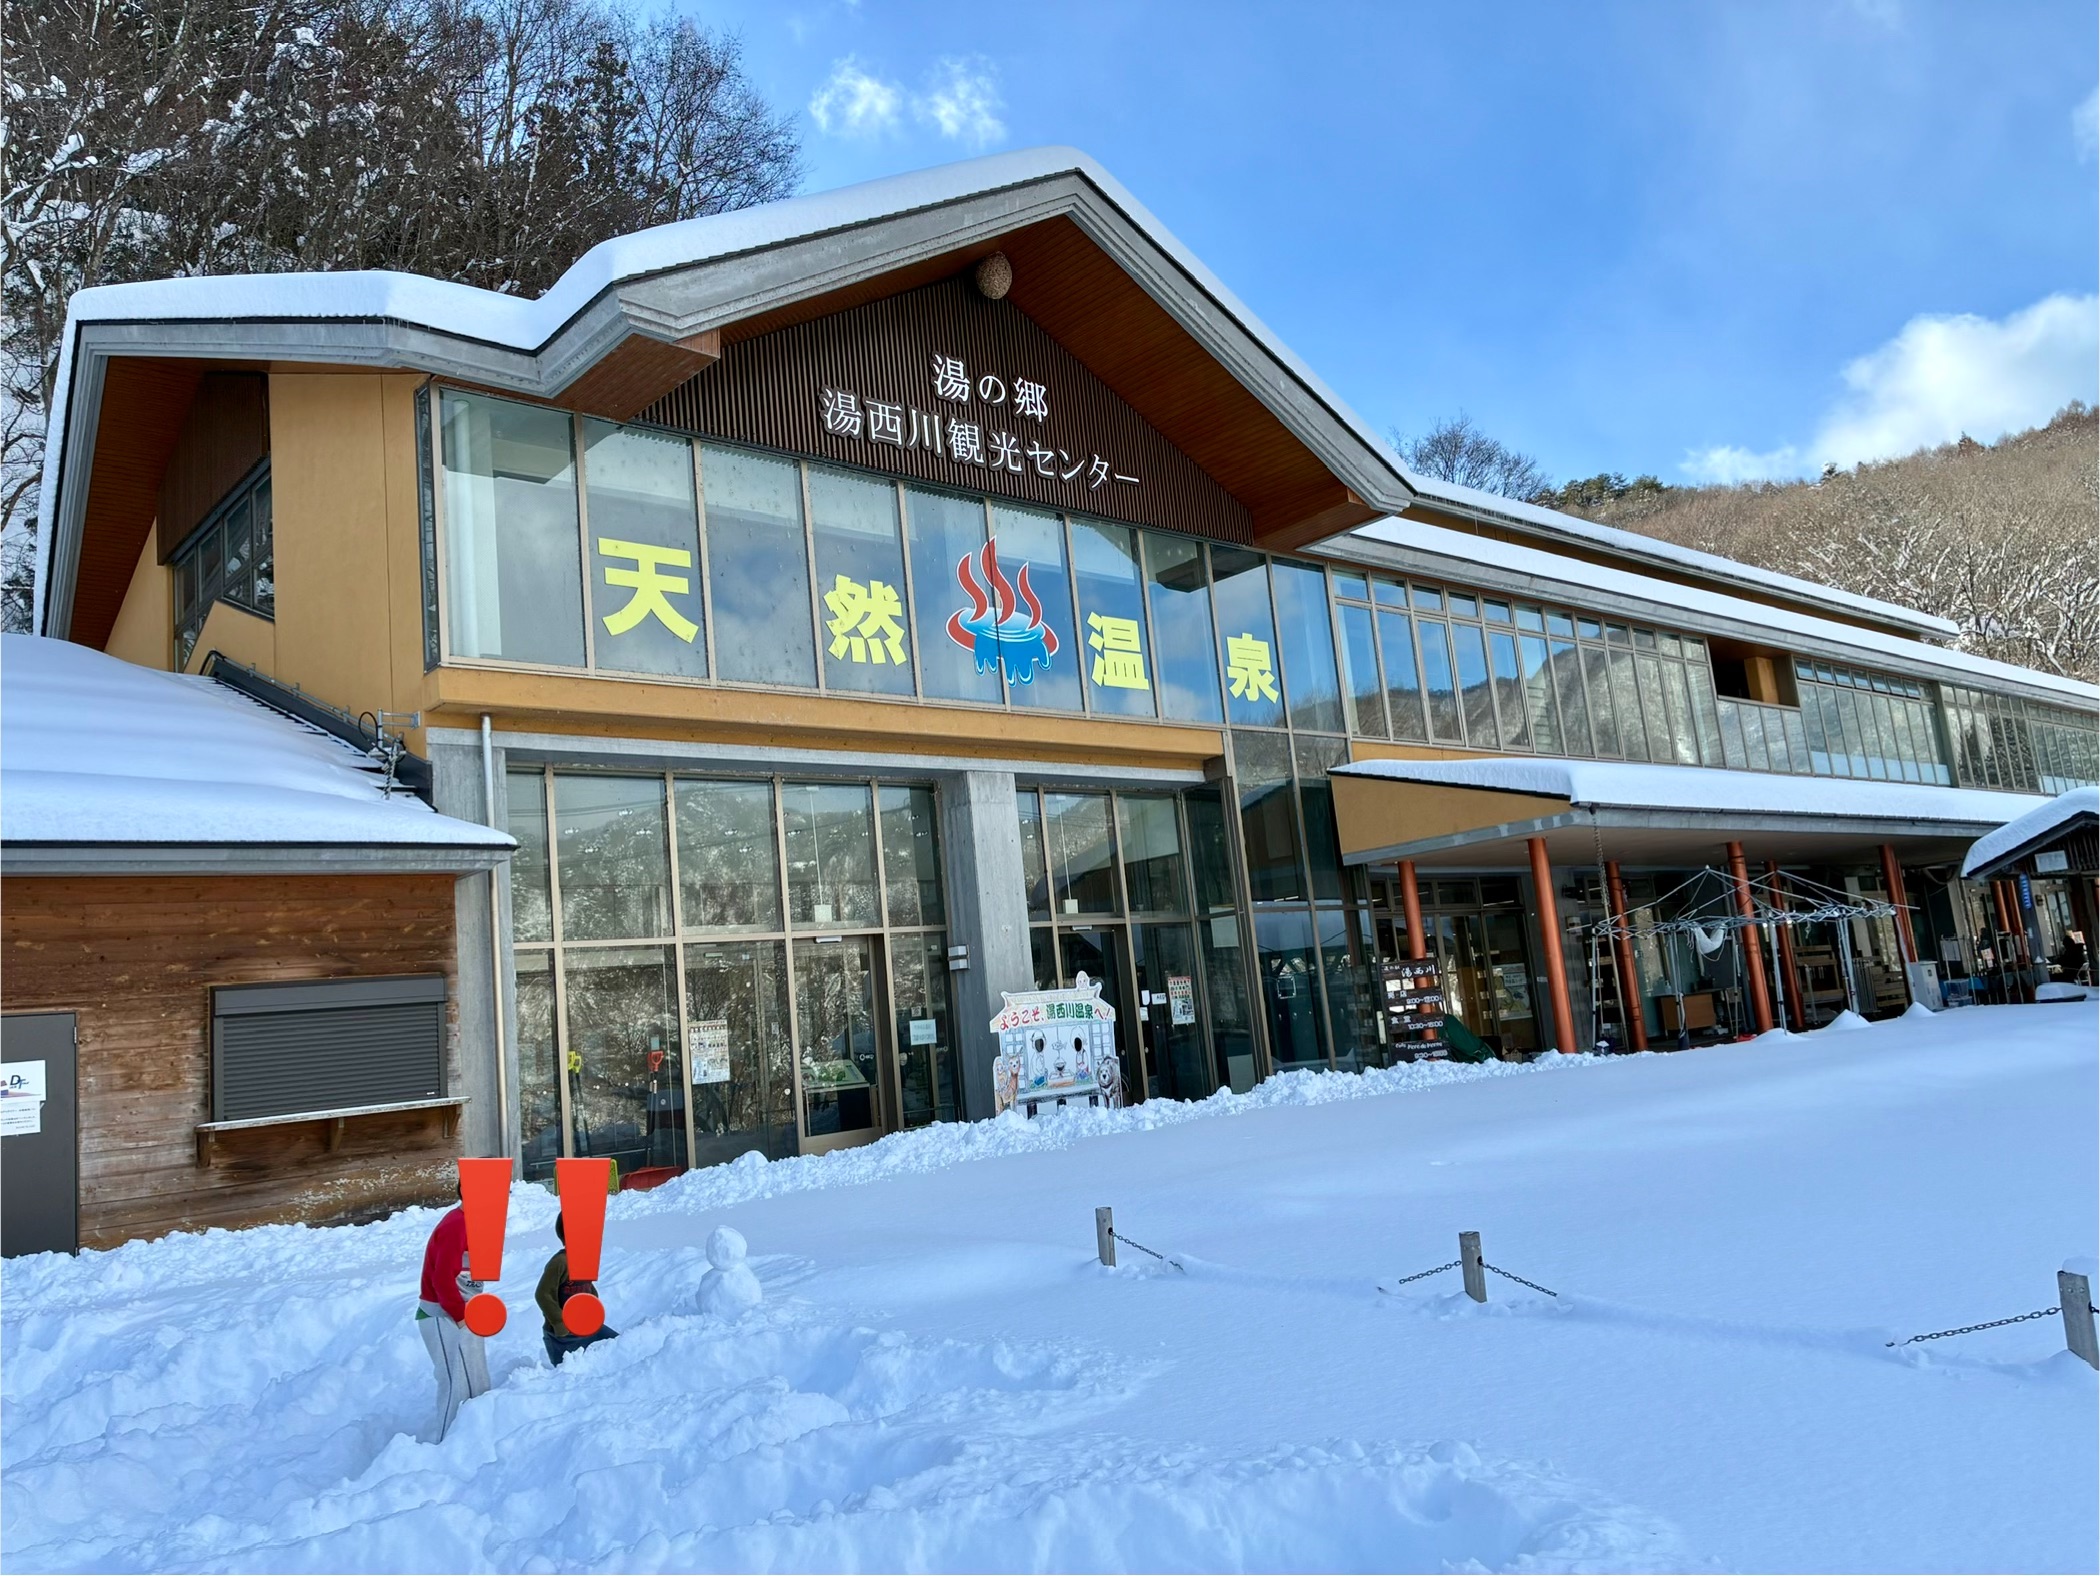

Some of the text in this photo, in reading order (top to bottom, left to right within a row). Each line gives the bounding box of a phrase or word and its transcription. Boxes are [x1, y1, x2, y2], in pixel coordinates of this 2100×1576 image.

[932, 353, 1049, 423] 湯の郷
[823, 388, 1140, 489] 湯西川観光センター
[1401, 964, 1436, 978] 湯西川
